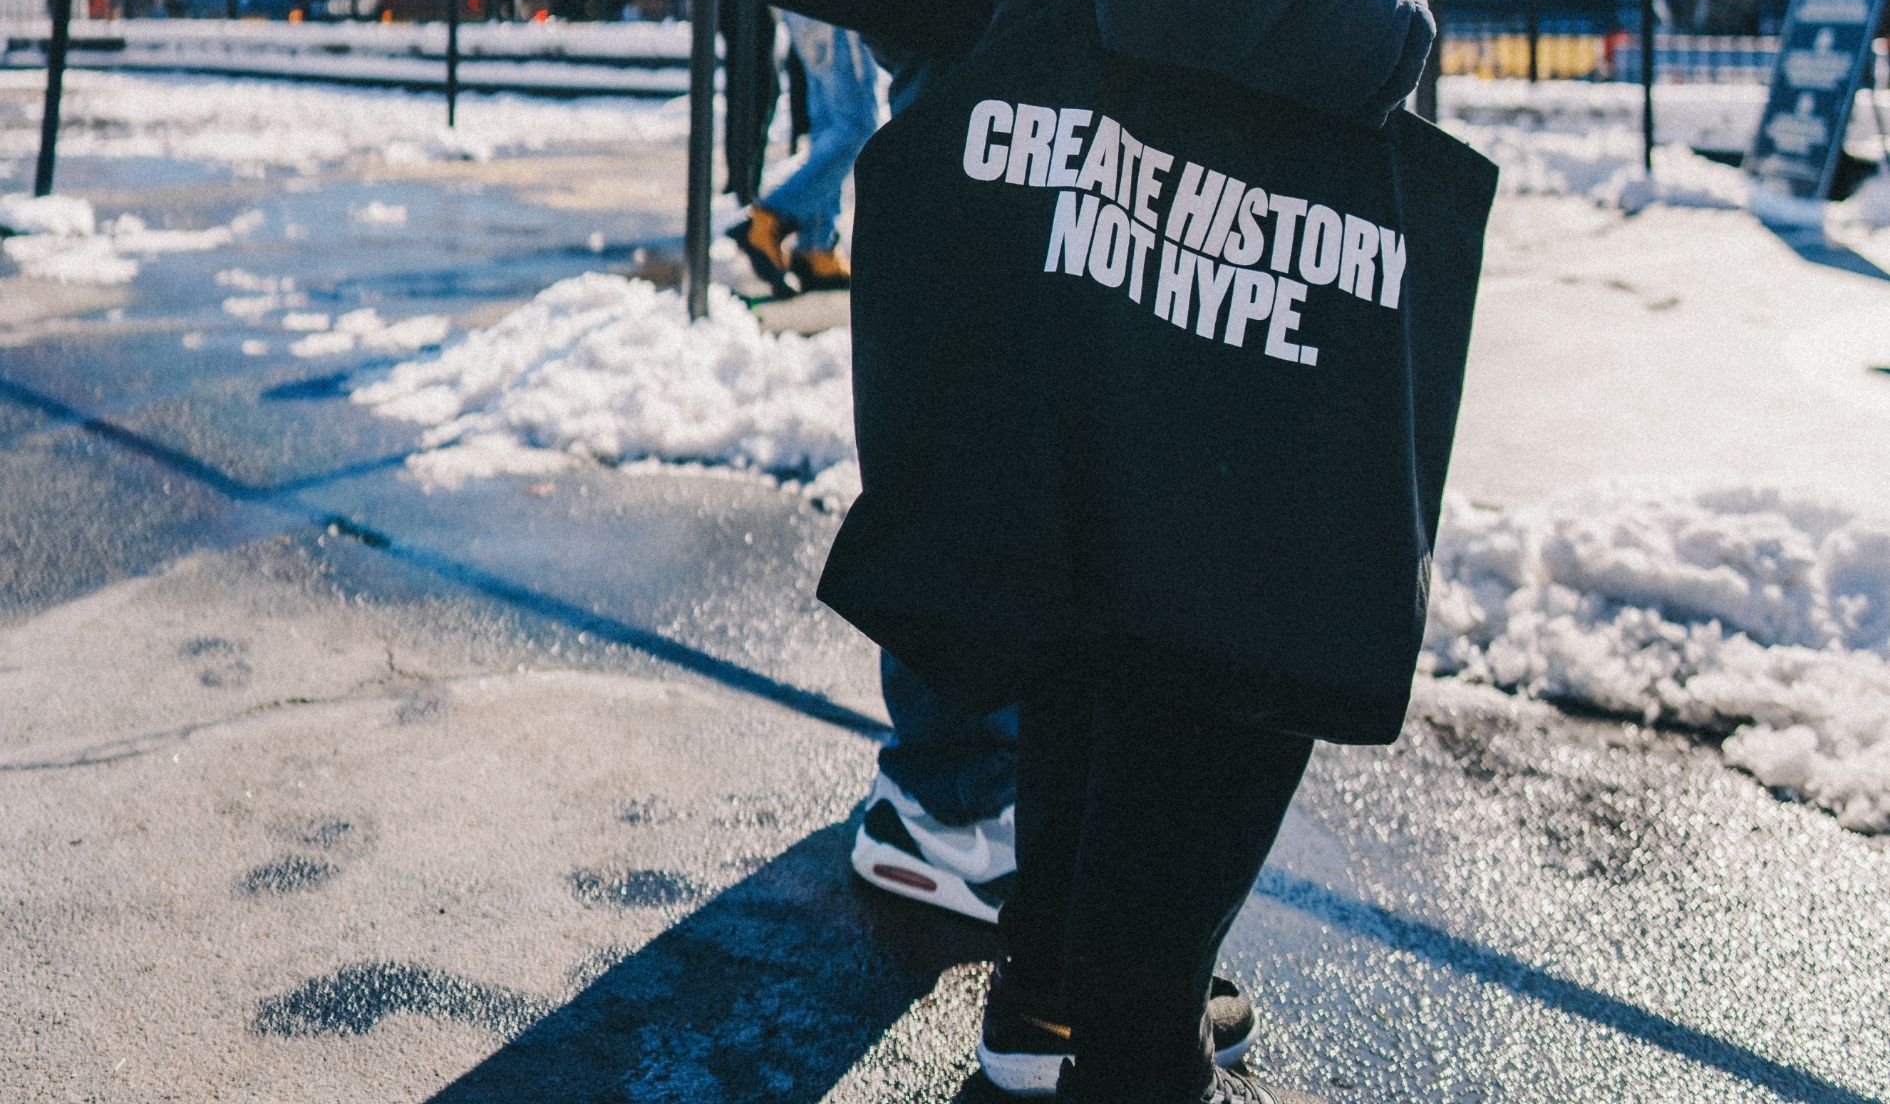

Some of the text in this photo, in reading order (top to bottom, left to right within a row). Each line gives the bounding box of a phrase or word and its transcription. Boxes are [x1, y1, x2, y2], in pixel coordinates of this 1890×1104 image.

[963, 99, 1406, 309] CREATE HISTORY
[1044, 191, 1318, 366] NOT HYPE.
